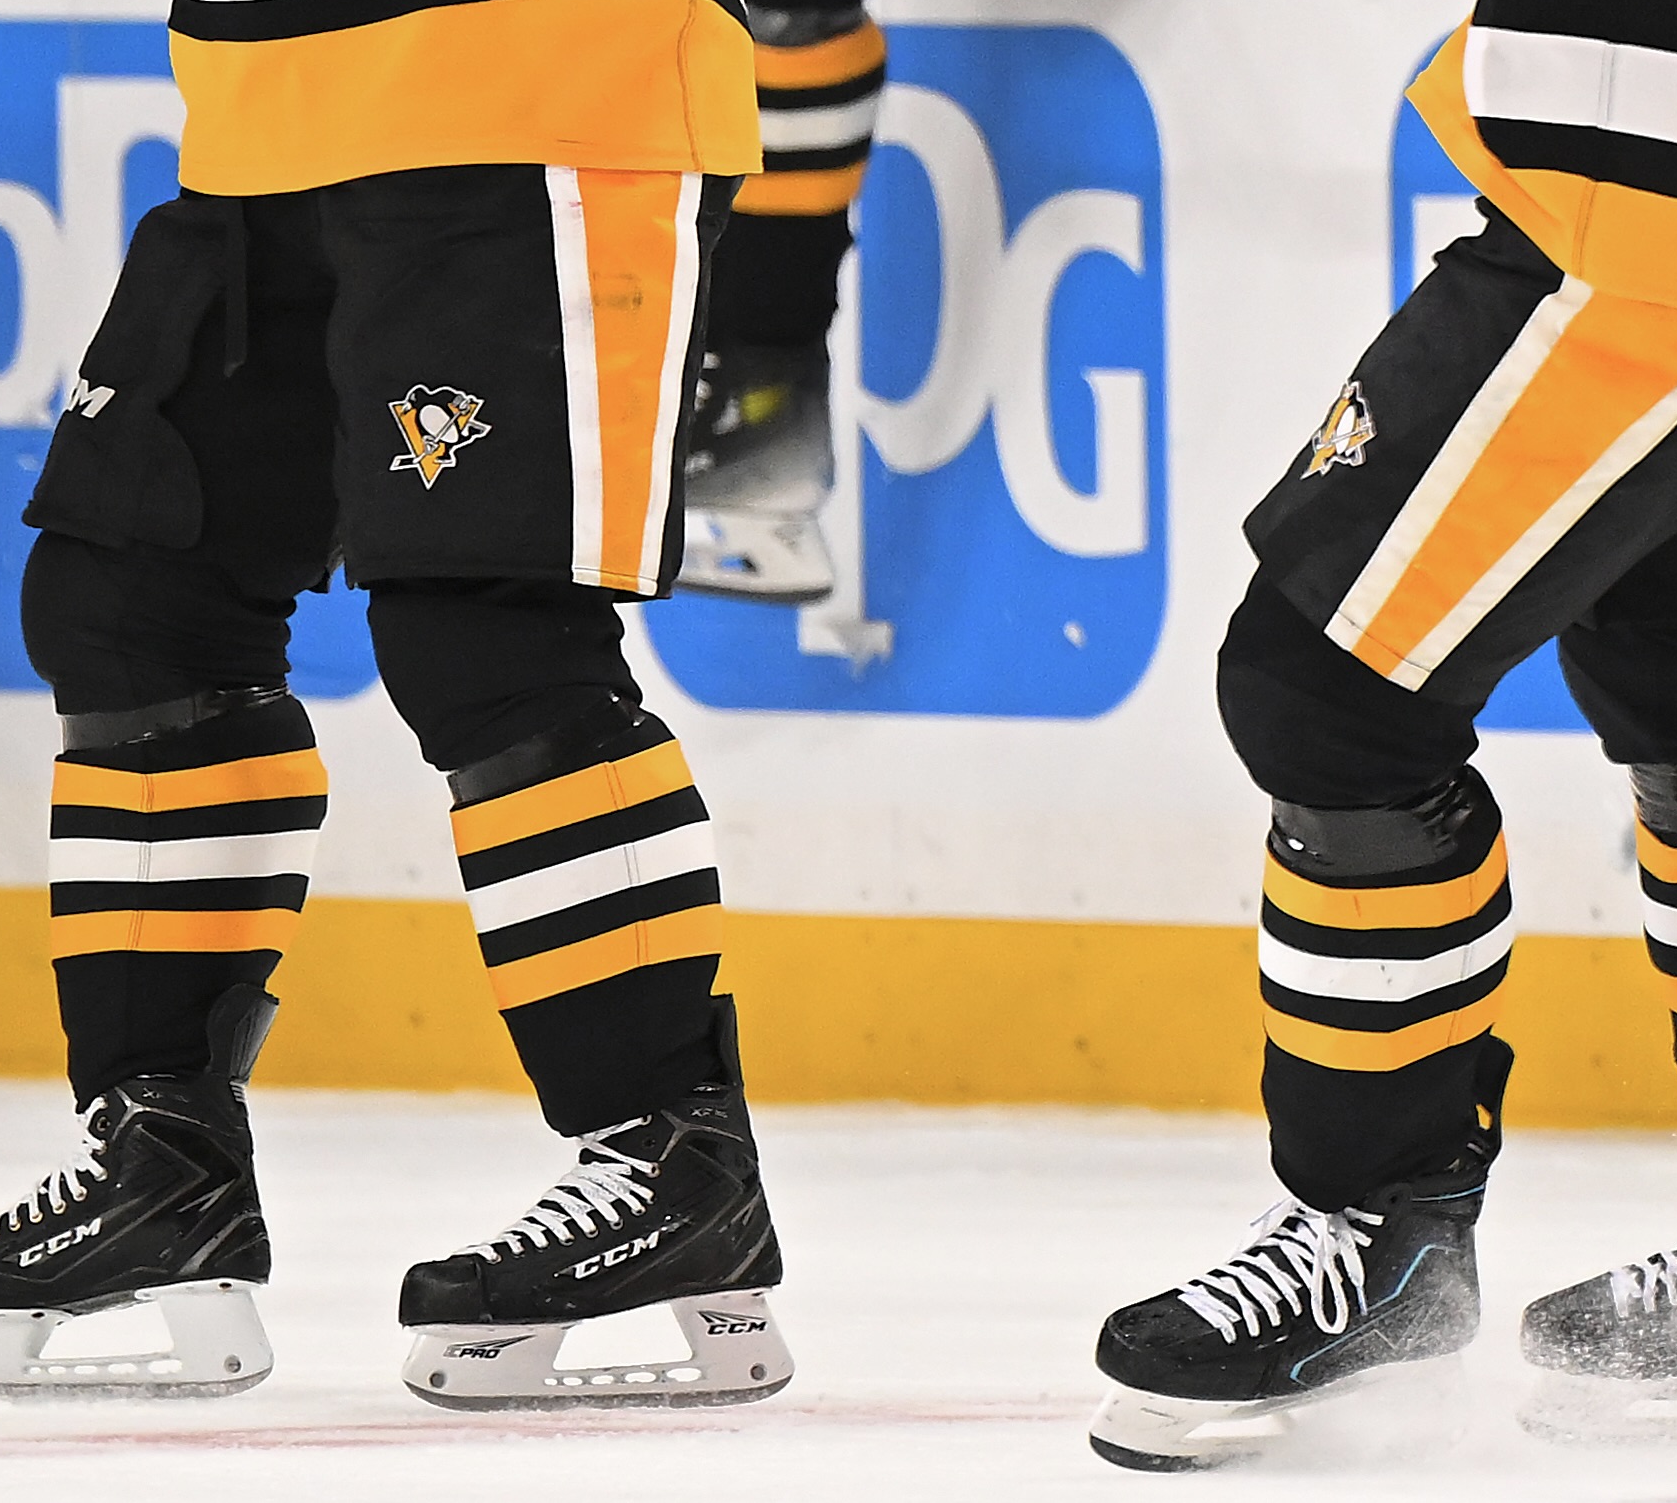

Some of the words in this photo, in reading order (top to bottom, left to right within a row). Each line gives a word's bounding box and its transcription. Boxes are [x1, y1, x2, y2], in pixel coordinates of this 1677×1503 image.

[18, 1218, 102, 1267] CCM
[574, 1229, 661, 1279] CCM
[707, 1320, 768, 1336] CCM
